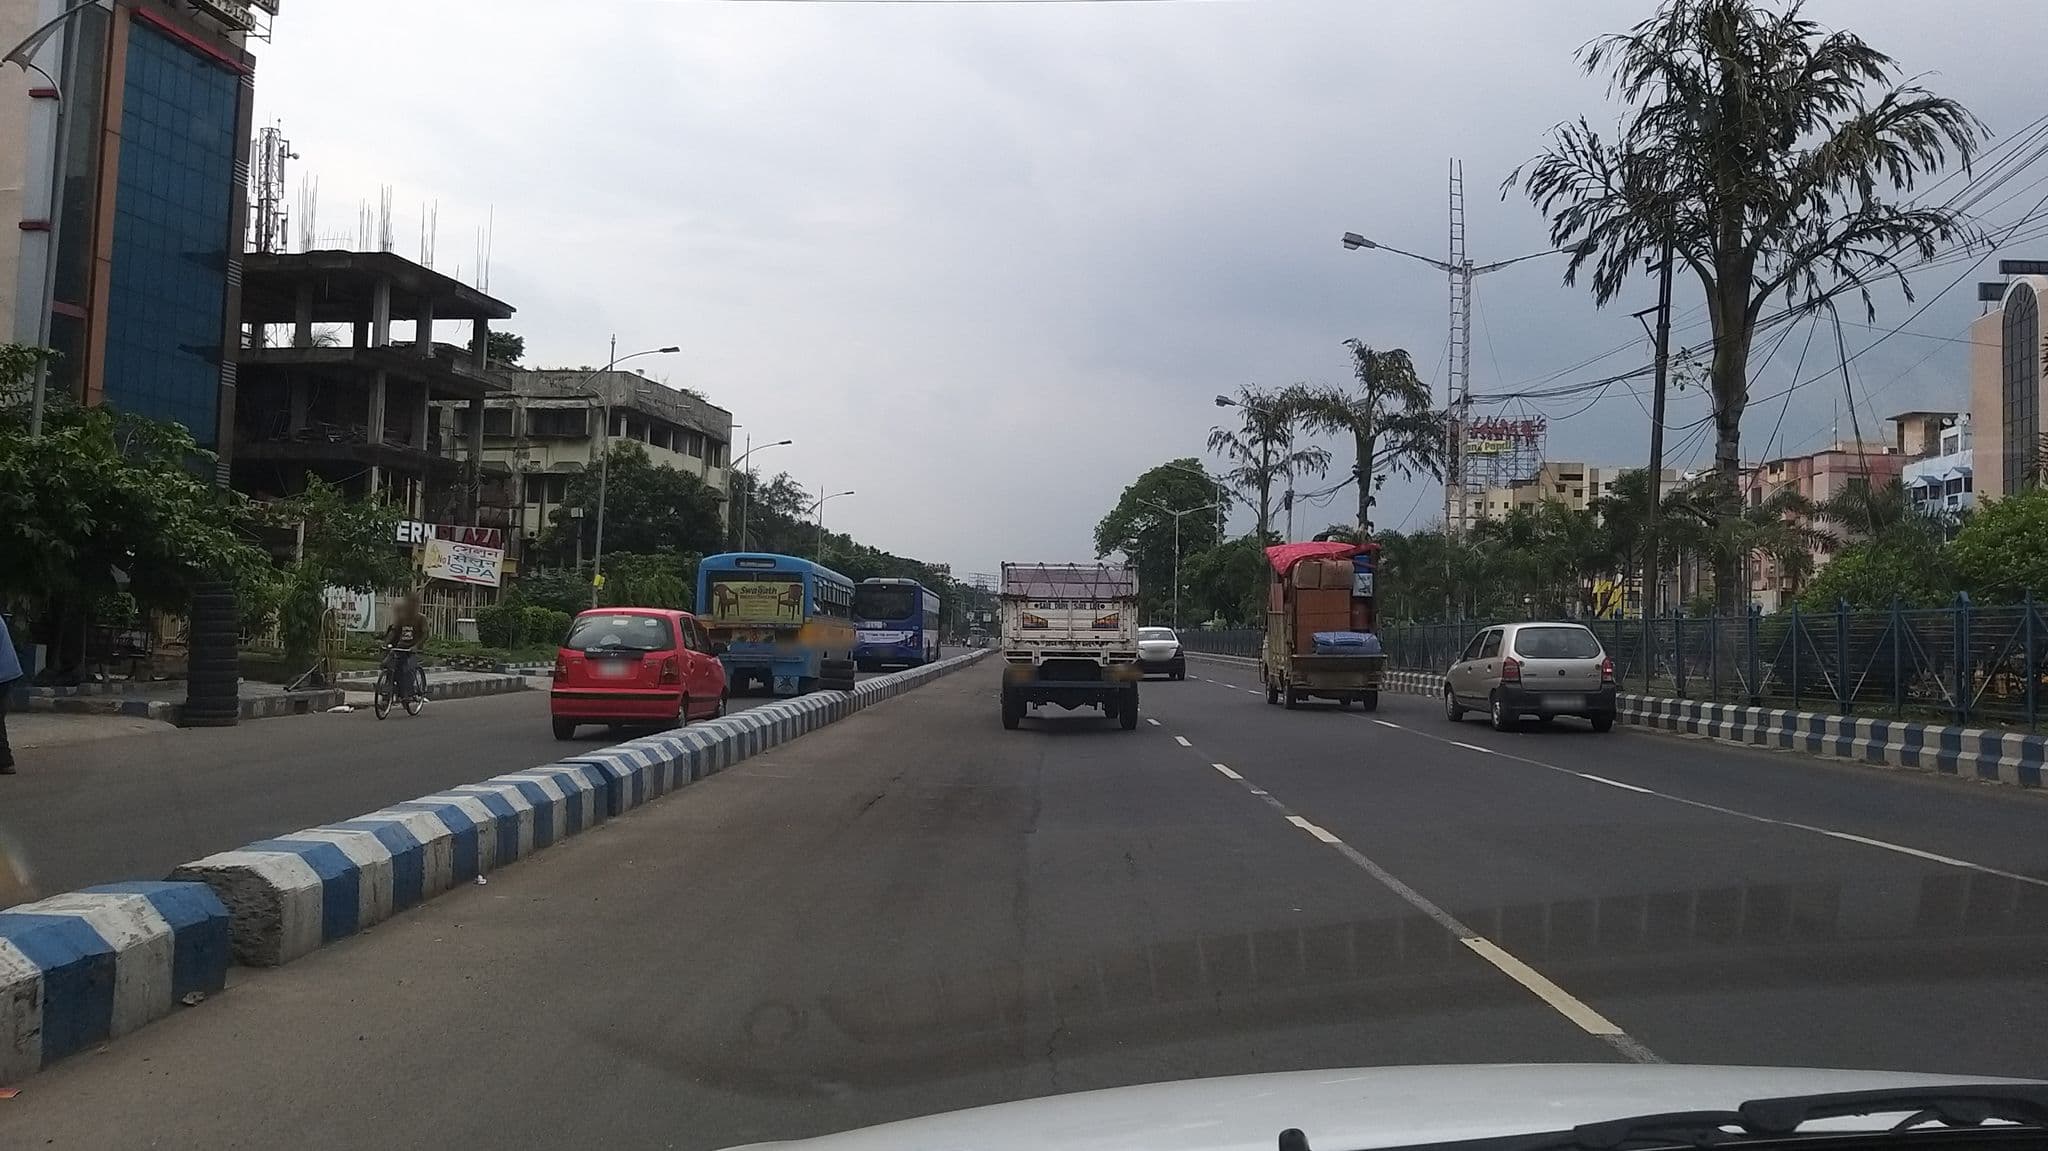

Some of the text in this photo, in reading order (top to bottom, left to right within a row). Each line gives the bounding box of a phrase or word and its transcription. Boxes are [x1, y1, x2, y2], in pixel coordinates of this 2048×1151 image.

[396, 521, 502, 549] ERN PLAZA
[449, 563, 496, 579] SPA
